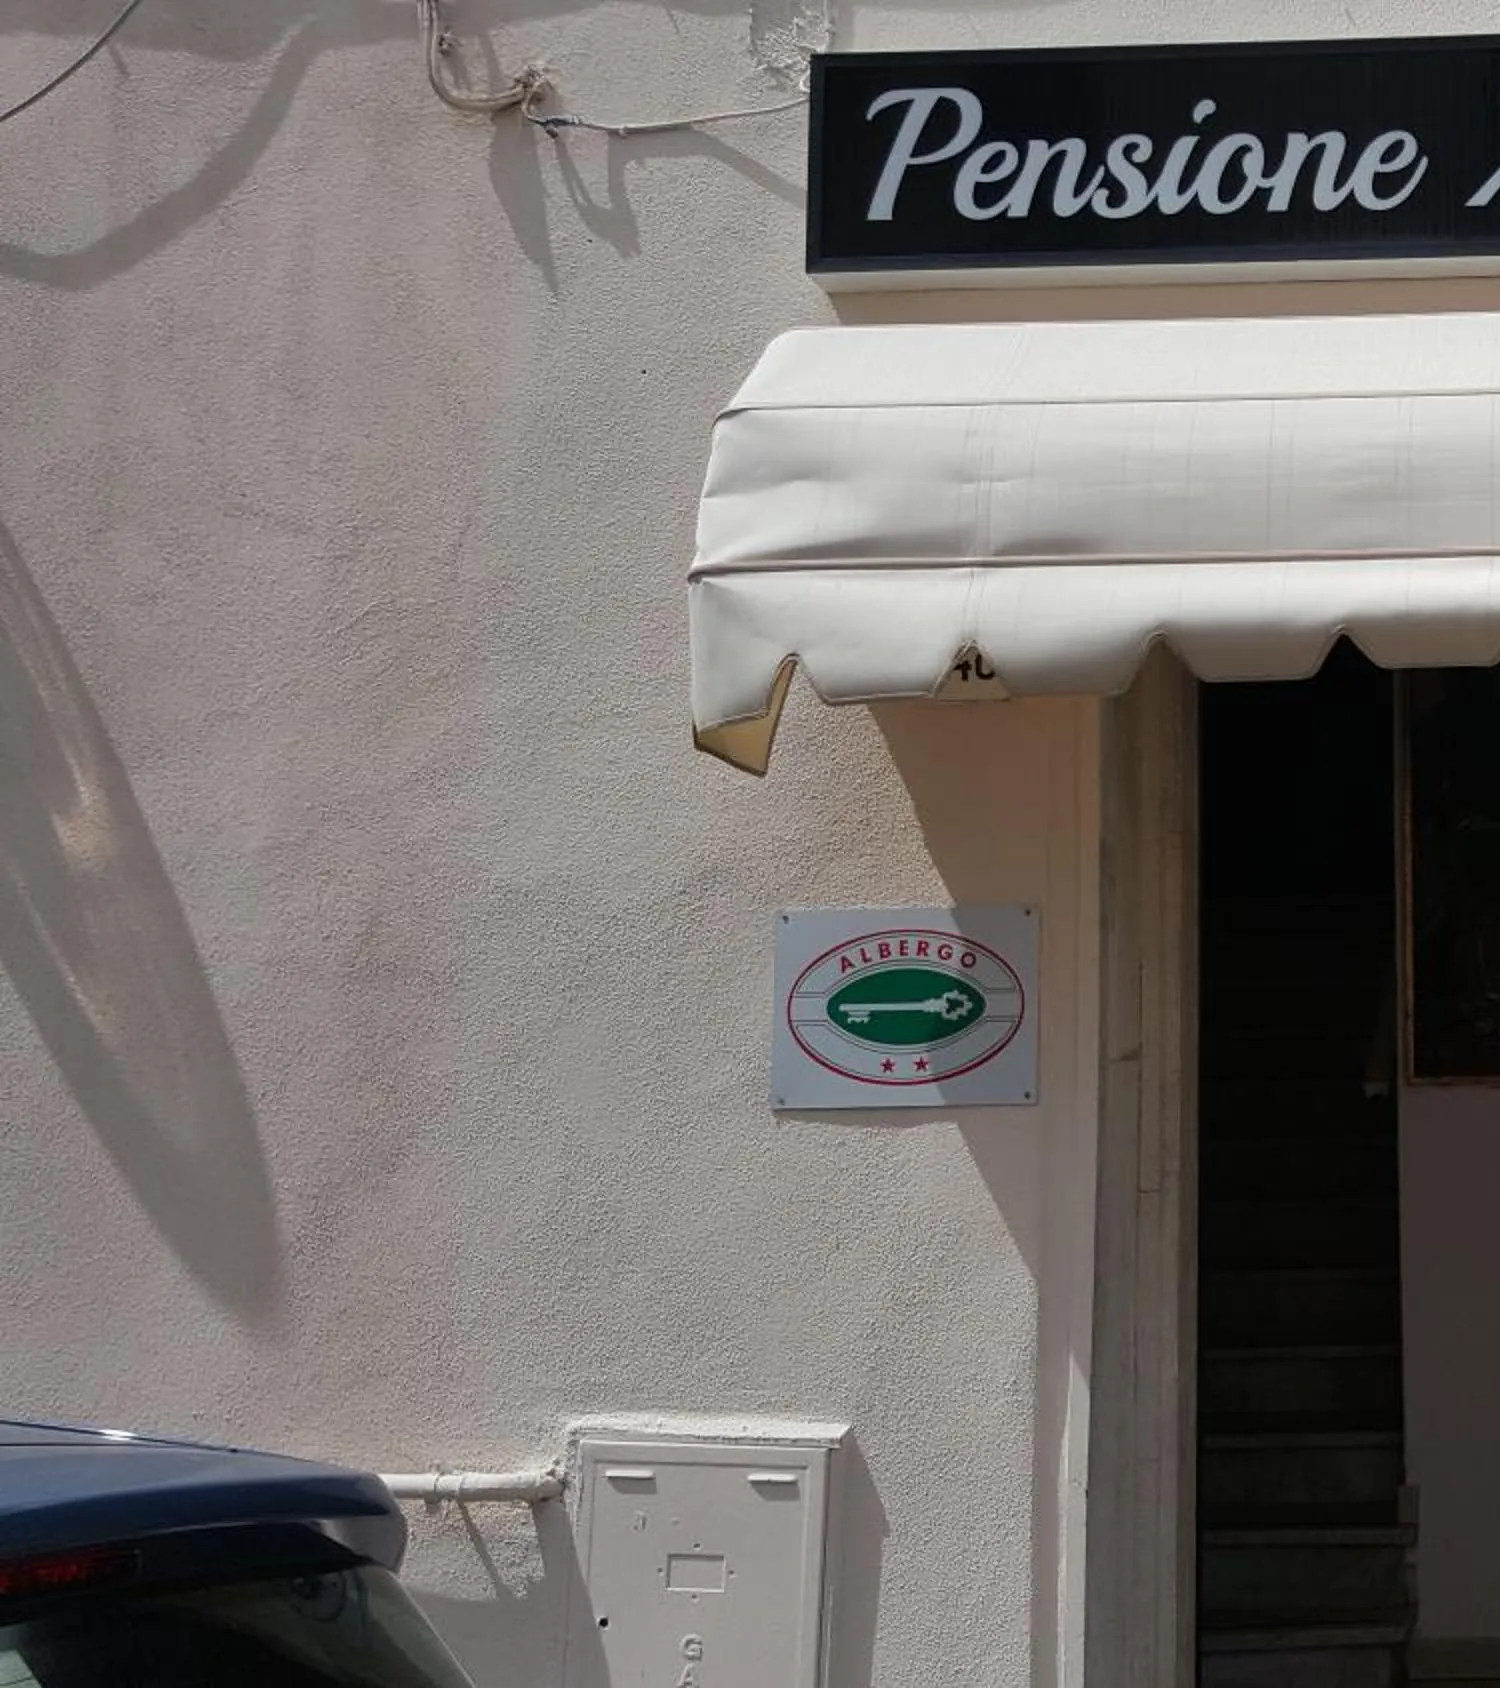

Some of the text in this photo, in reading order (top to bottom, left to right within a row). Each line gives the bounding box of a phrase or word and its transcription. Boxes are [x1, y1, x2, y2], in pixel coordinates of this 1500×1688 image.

[865, 86, 1429, 221] Pensione
[838, 938, 977, 974] ALBERGO
[676, 1632, 704, 1688] GA
